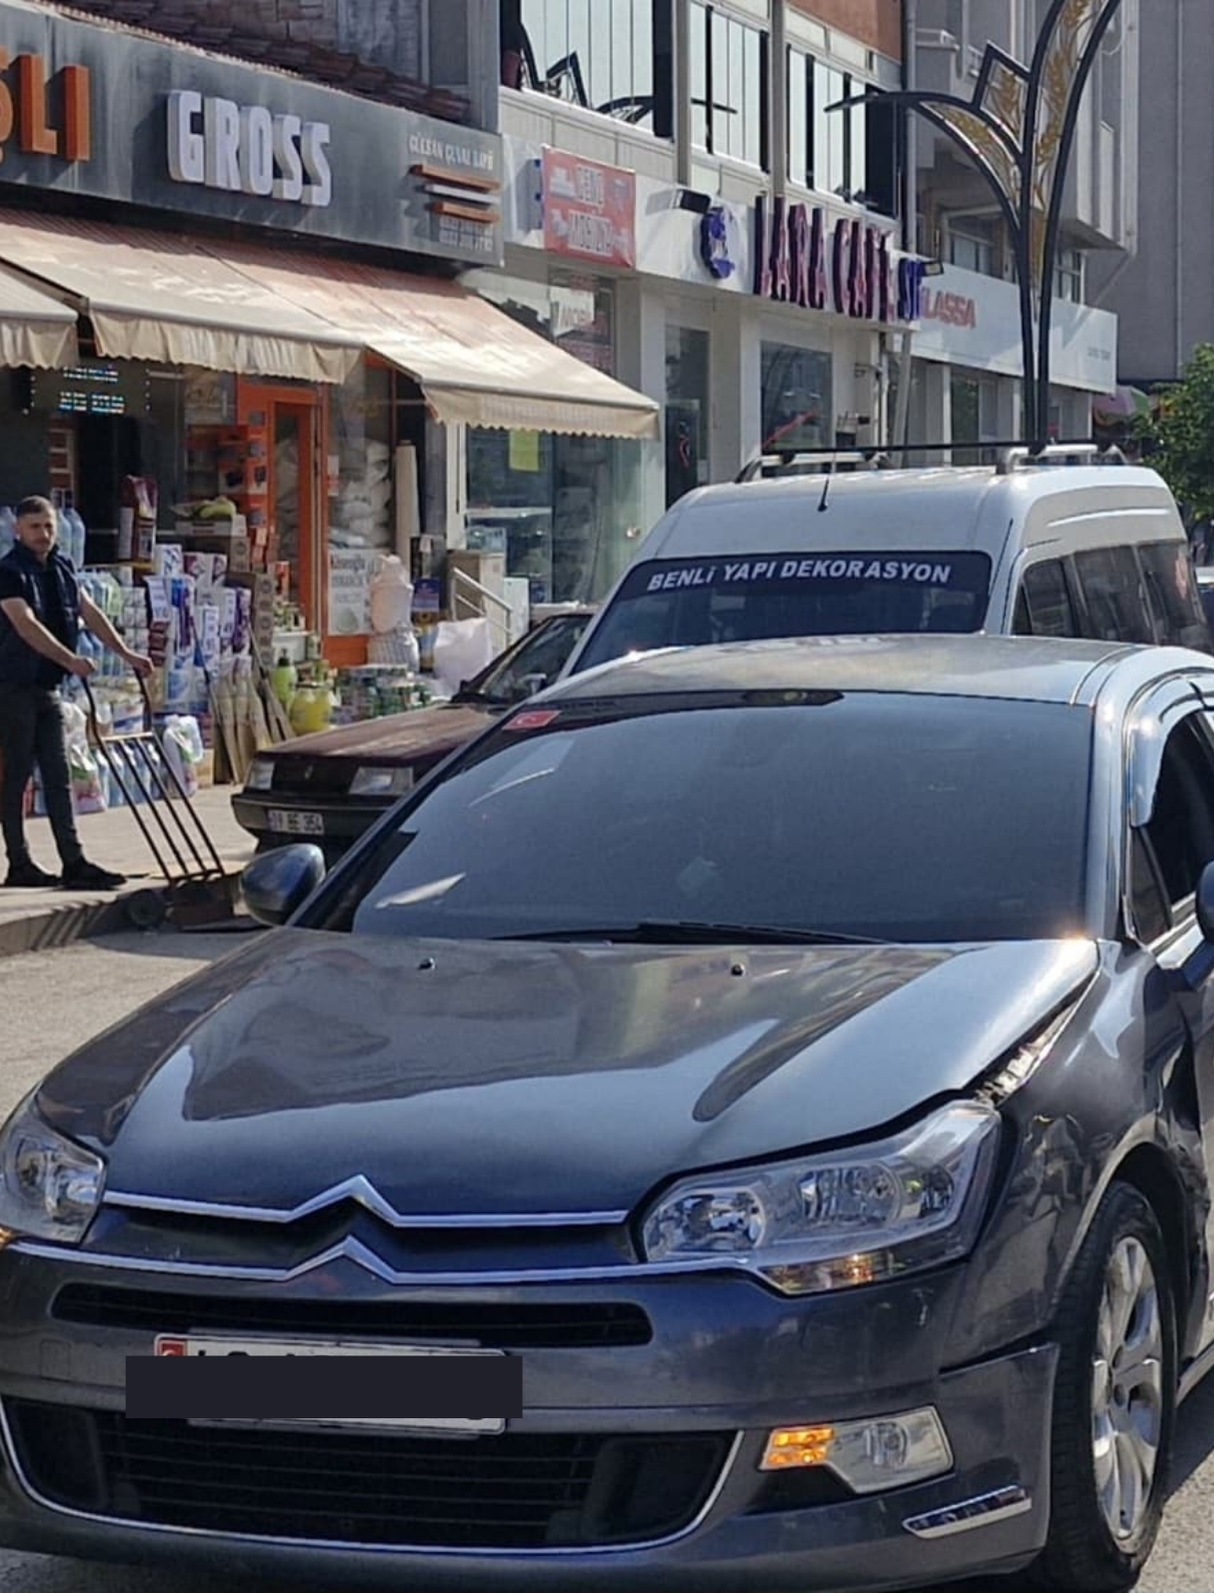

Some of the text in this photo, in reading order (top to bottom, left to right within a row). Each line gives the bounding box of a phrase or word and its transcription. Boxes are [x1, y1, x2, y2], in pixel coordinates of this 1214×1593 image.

[167, 89, 332, 207] GROSS
[753, 194, 829, 309] LARA
[921, 286, 977, 330] LASSA
[723, 561, 778, 582] YAPI
[779, 560, 951, 583] DEKORASYON
